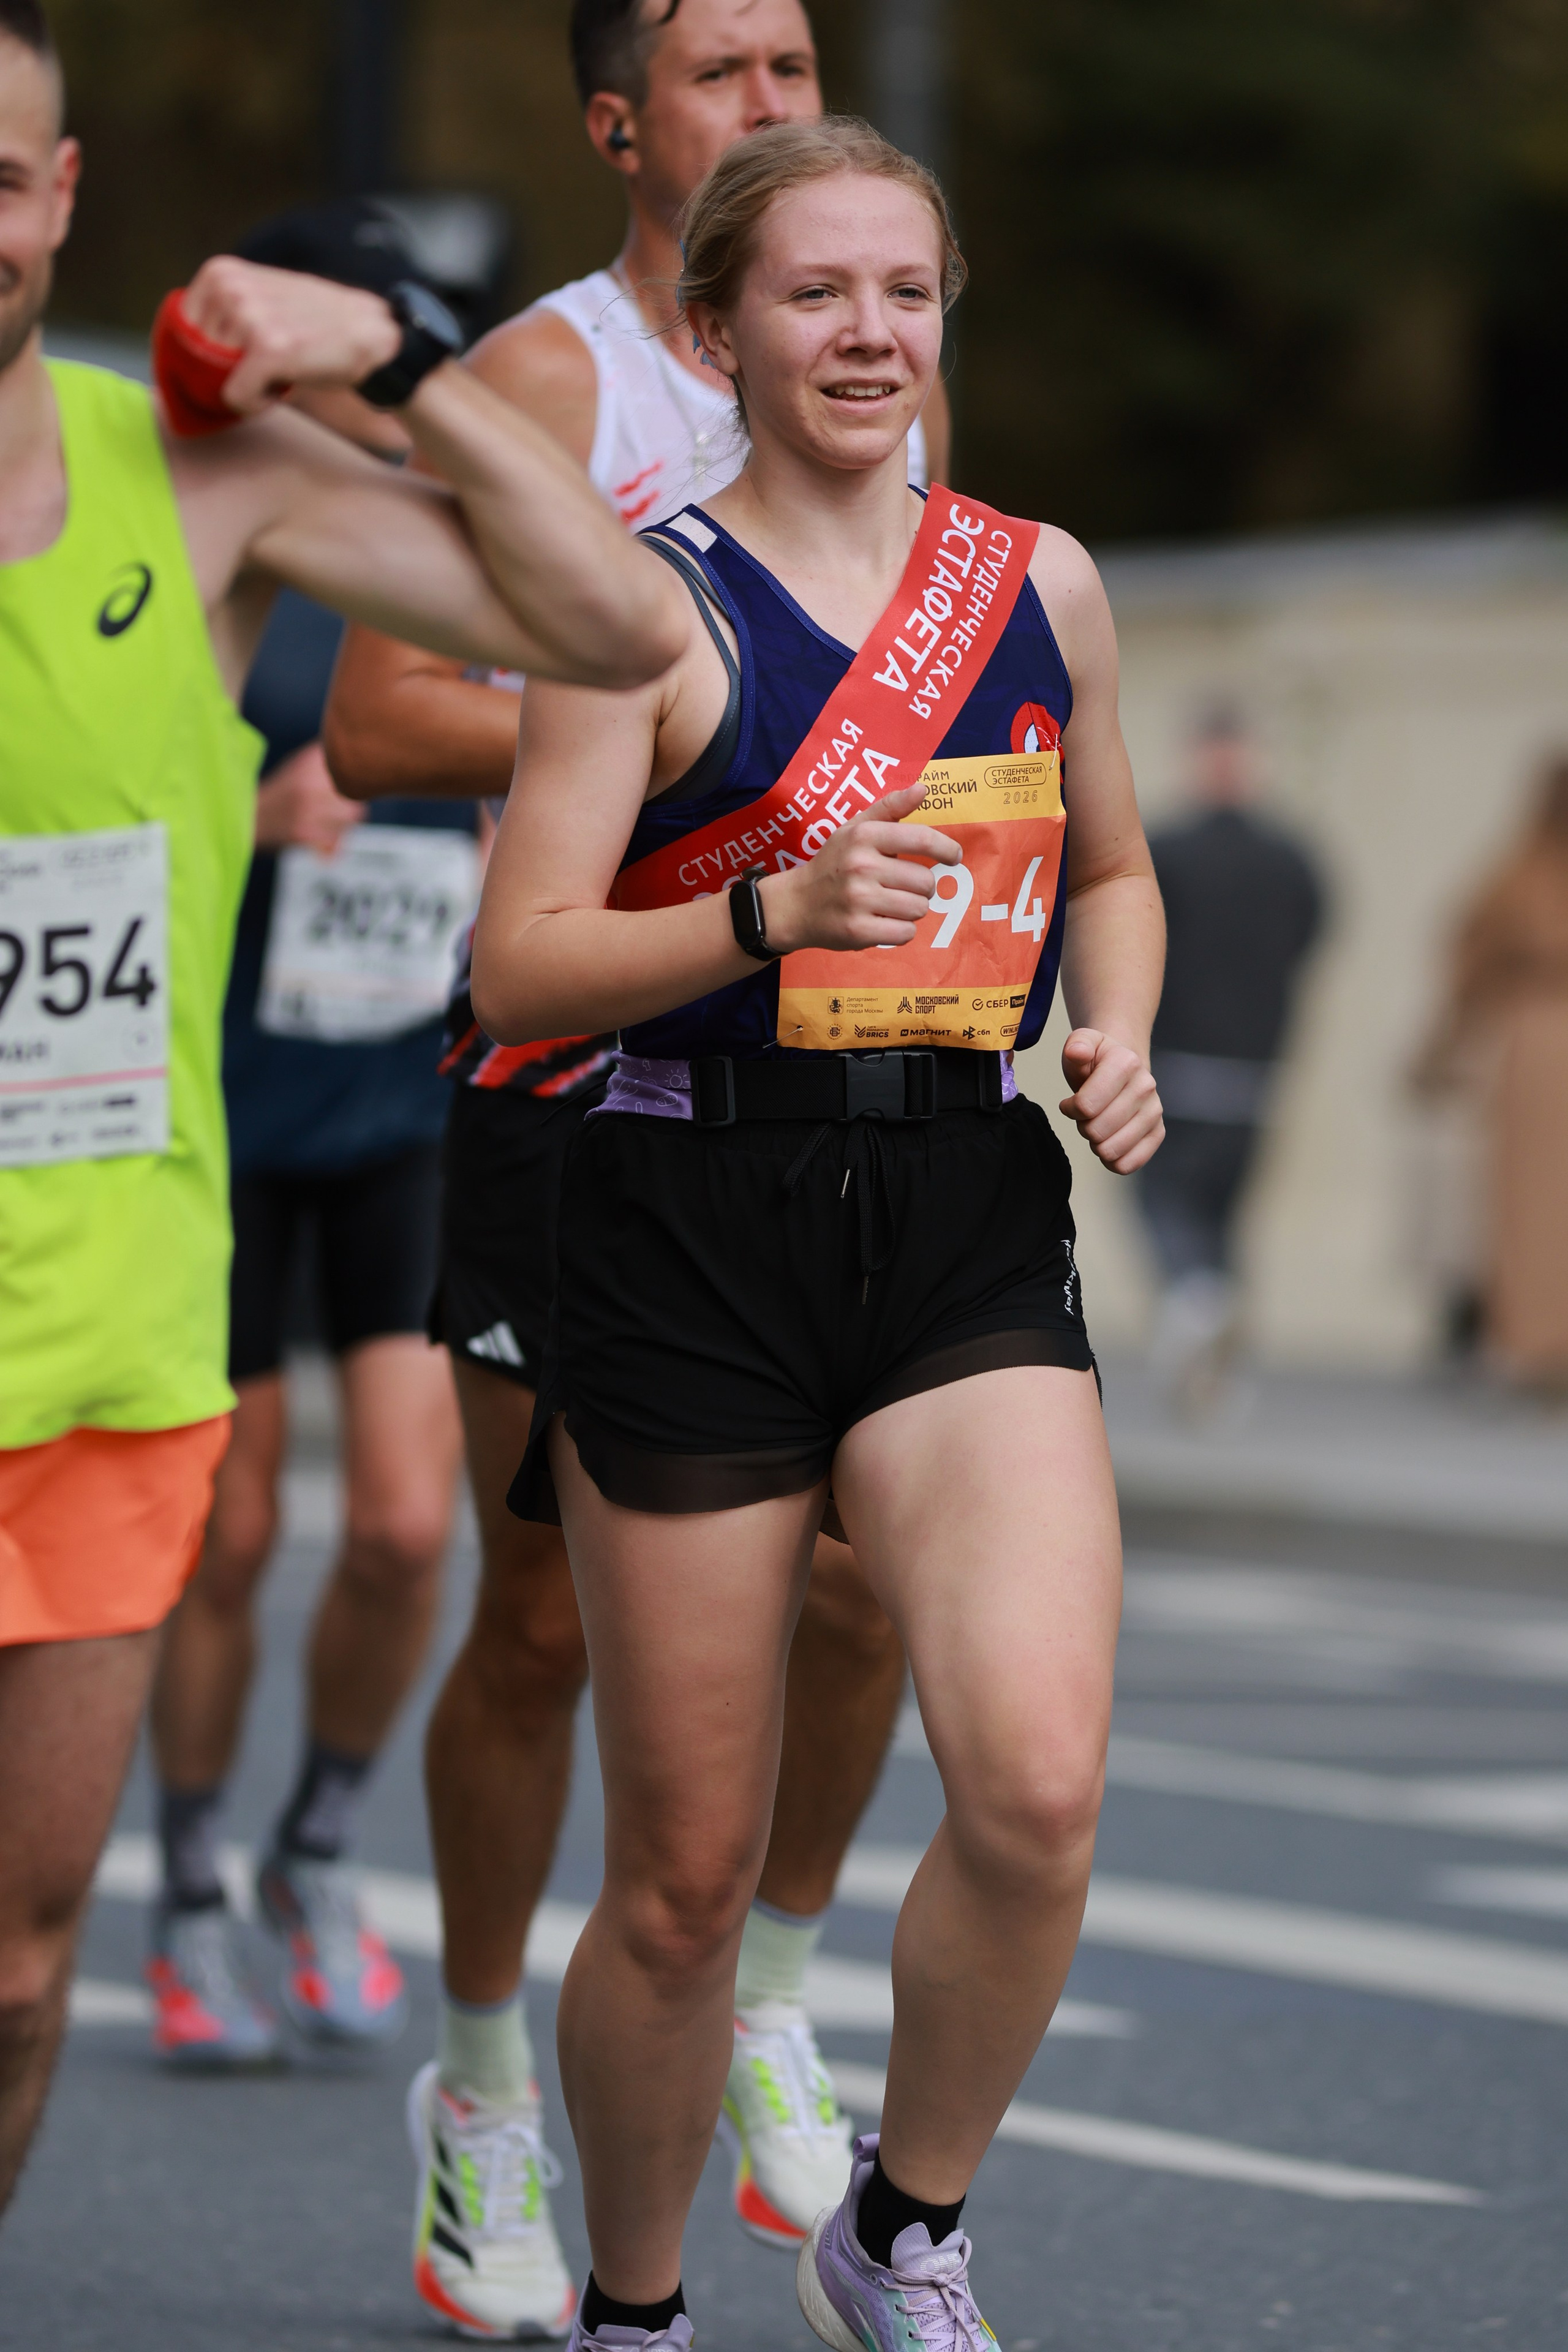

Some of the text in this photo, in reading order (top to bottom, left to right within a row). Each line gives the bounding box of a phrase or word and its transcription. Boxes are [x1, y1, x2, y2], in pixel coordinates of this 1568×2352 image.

[873, 503, 984, 692] ЭСТАФЕТА
[908, 530, 1012, 720] СТУДЕНЧЕСКАЯ
[917, 769, 949, 782] РАЙМ
[991, 766, 1042, 777] СТУДЕНЧЕСКАЯ
[924, 778, 978, 796] ОВСКИЙ
[992, 776, 1030, 785] ЭСТАФЕТА
[677, 718, 864, 886] СТУДЕНЧЕСКАЯ
[918, 797, 953, 811] ФОН
[1003, 790, 1038, 805] 2026
[693, 747, 900, 901] АФЕТА
[875, 856, 1046, 949] 9-4
[915, 994, 959, 1005] МОСКОВСКИЙ
[986, 999, 1009, 1008] СБЕР
[915, 1005, 937, 1014] СПОРТ
